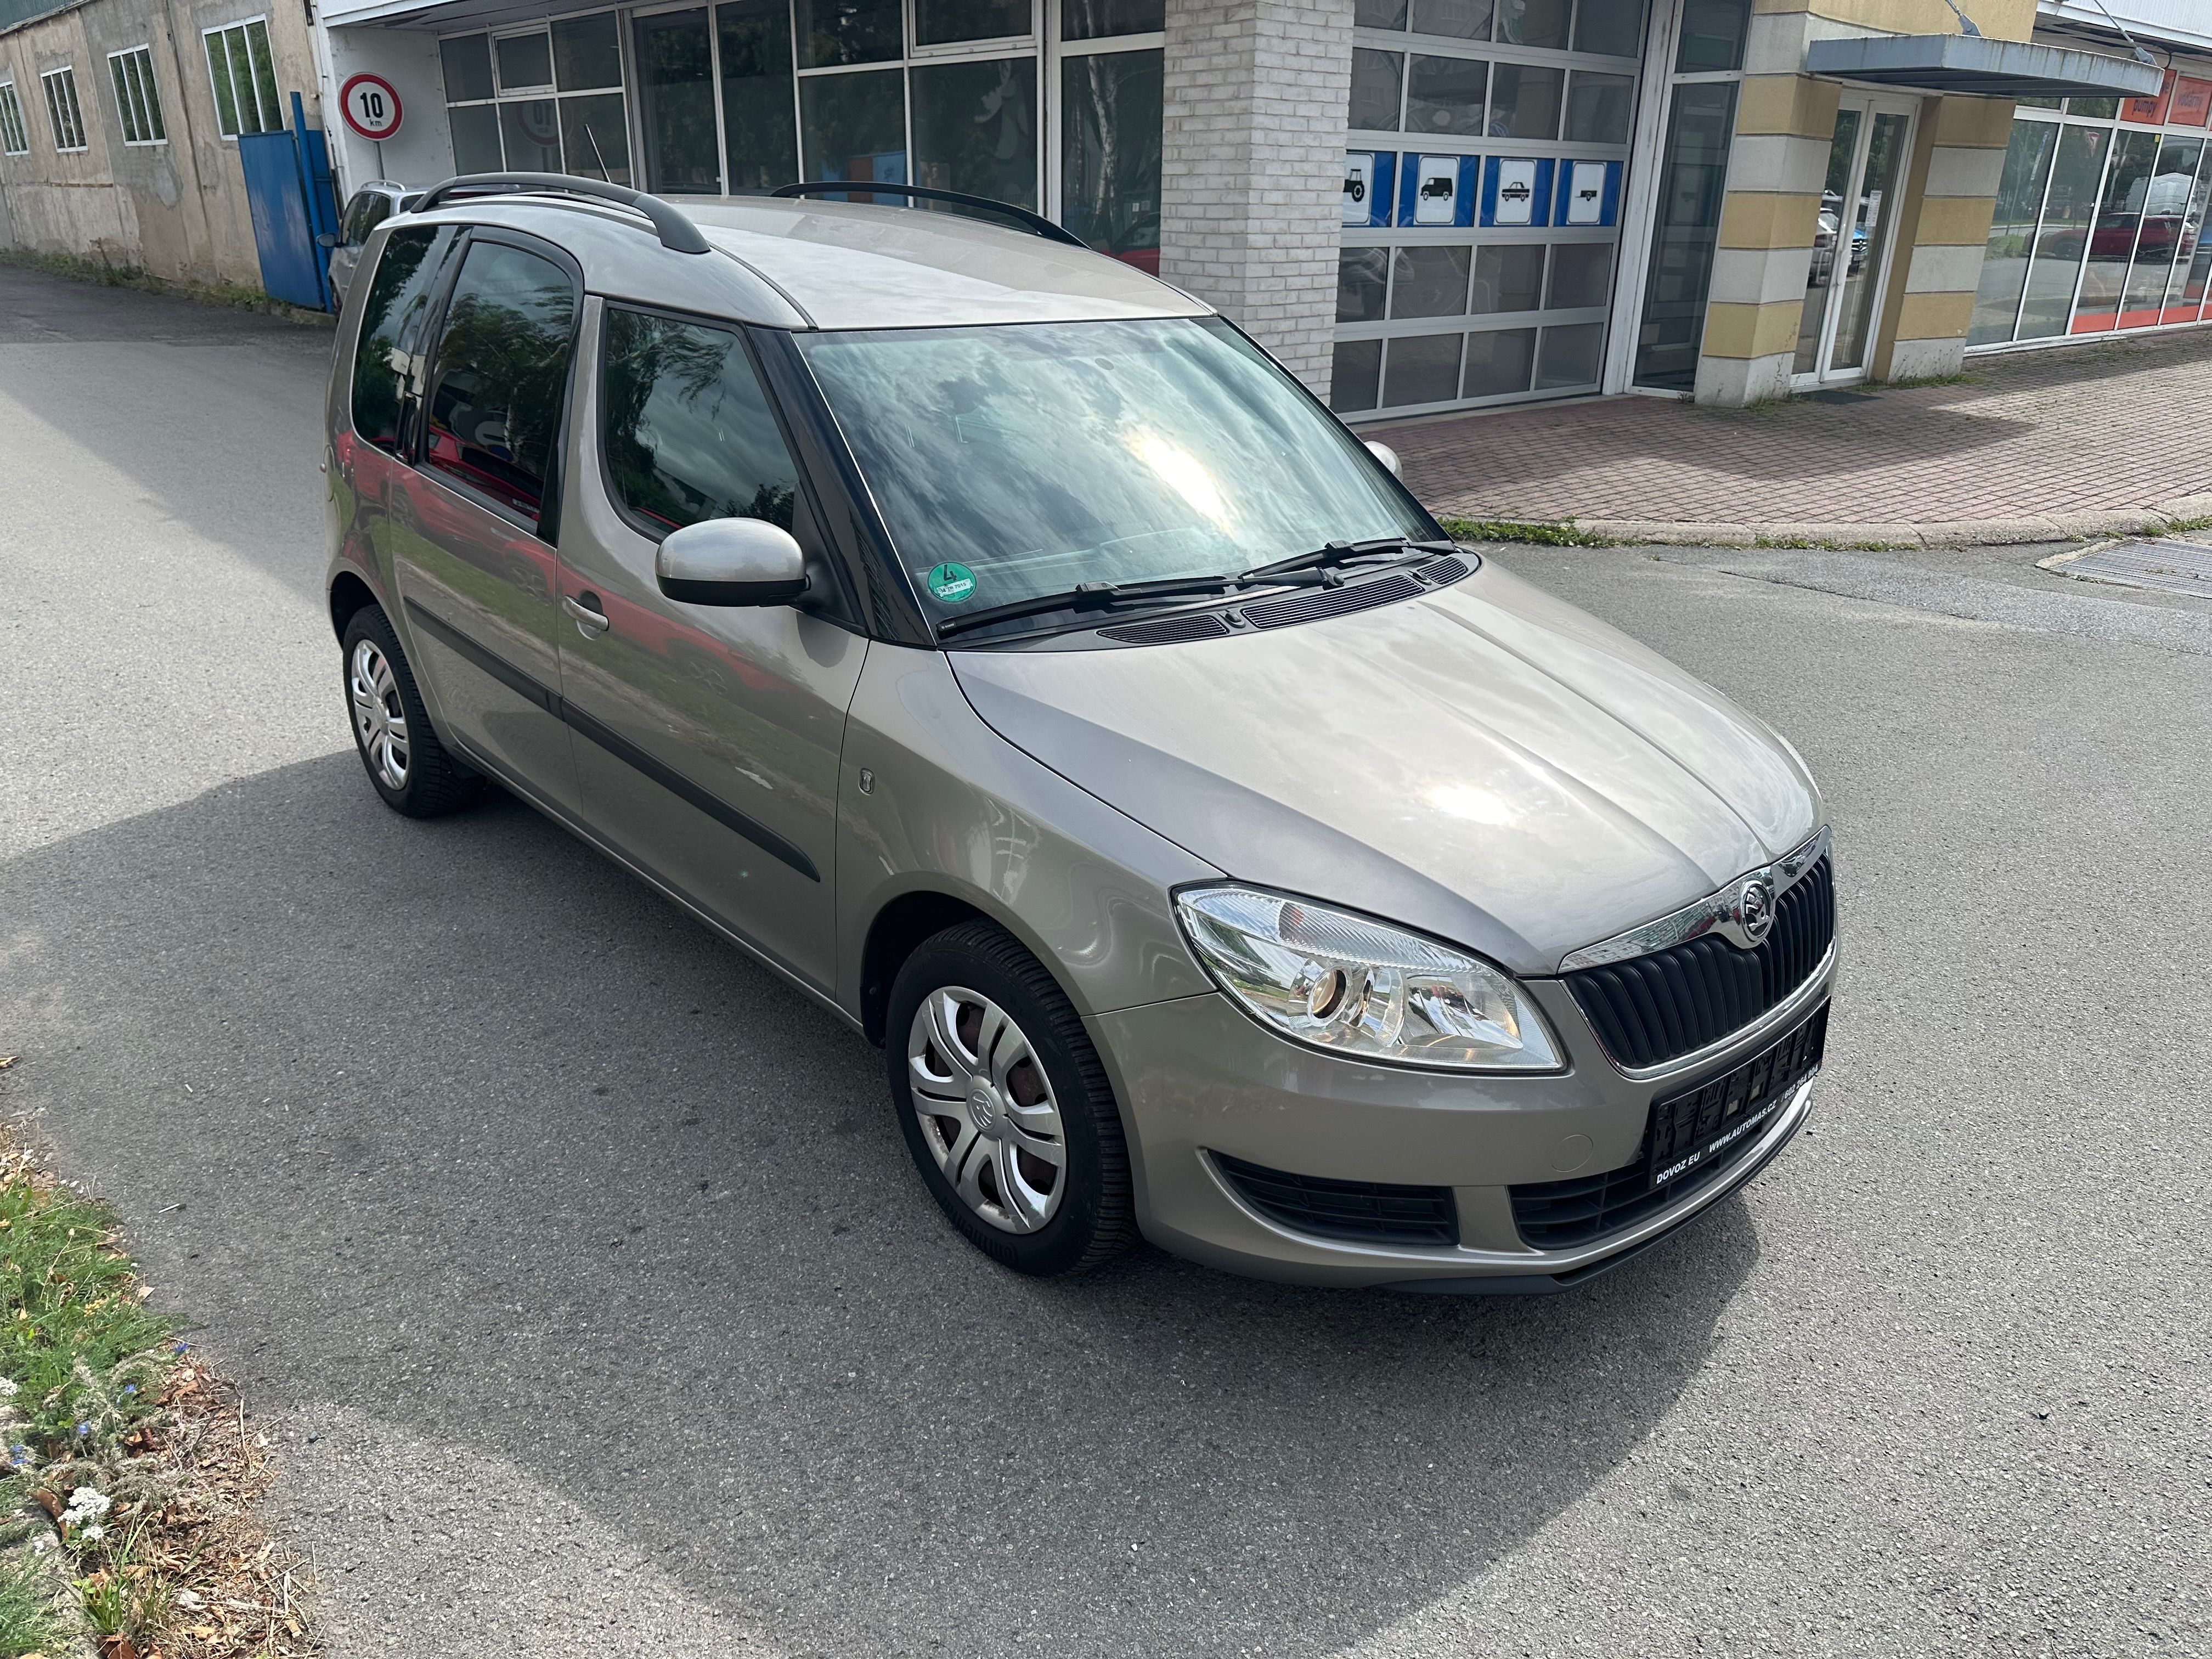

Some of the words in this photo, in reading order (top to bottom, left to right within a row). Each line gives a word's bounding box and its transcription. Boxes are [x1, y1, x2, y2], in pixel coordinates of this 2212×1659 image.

[360, 92, 383, 118] 10
[2131, 99, 2158, 119] pumpy
[944, 565, 957, 582] 4
[1656, 1159, 1686, 1184] DOVOZ
[1688, 1152, 1701, 1166] EU
[1708, 1099, 1777, 1153] WWW.AUTOMAS.CZ
[1785, 1084, 1796, 1099] 602
